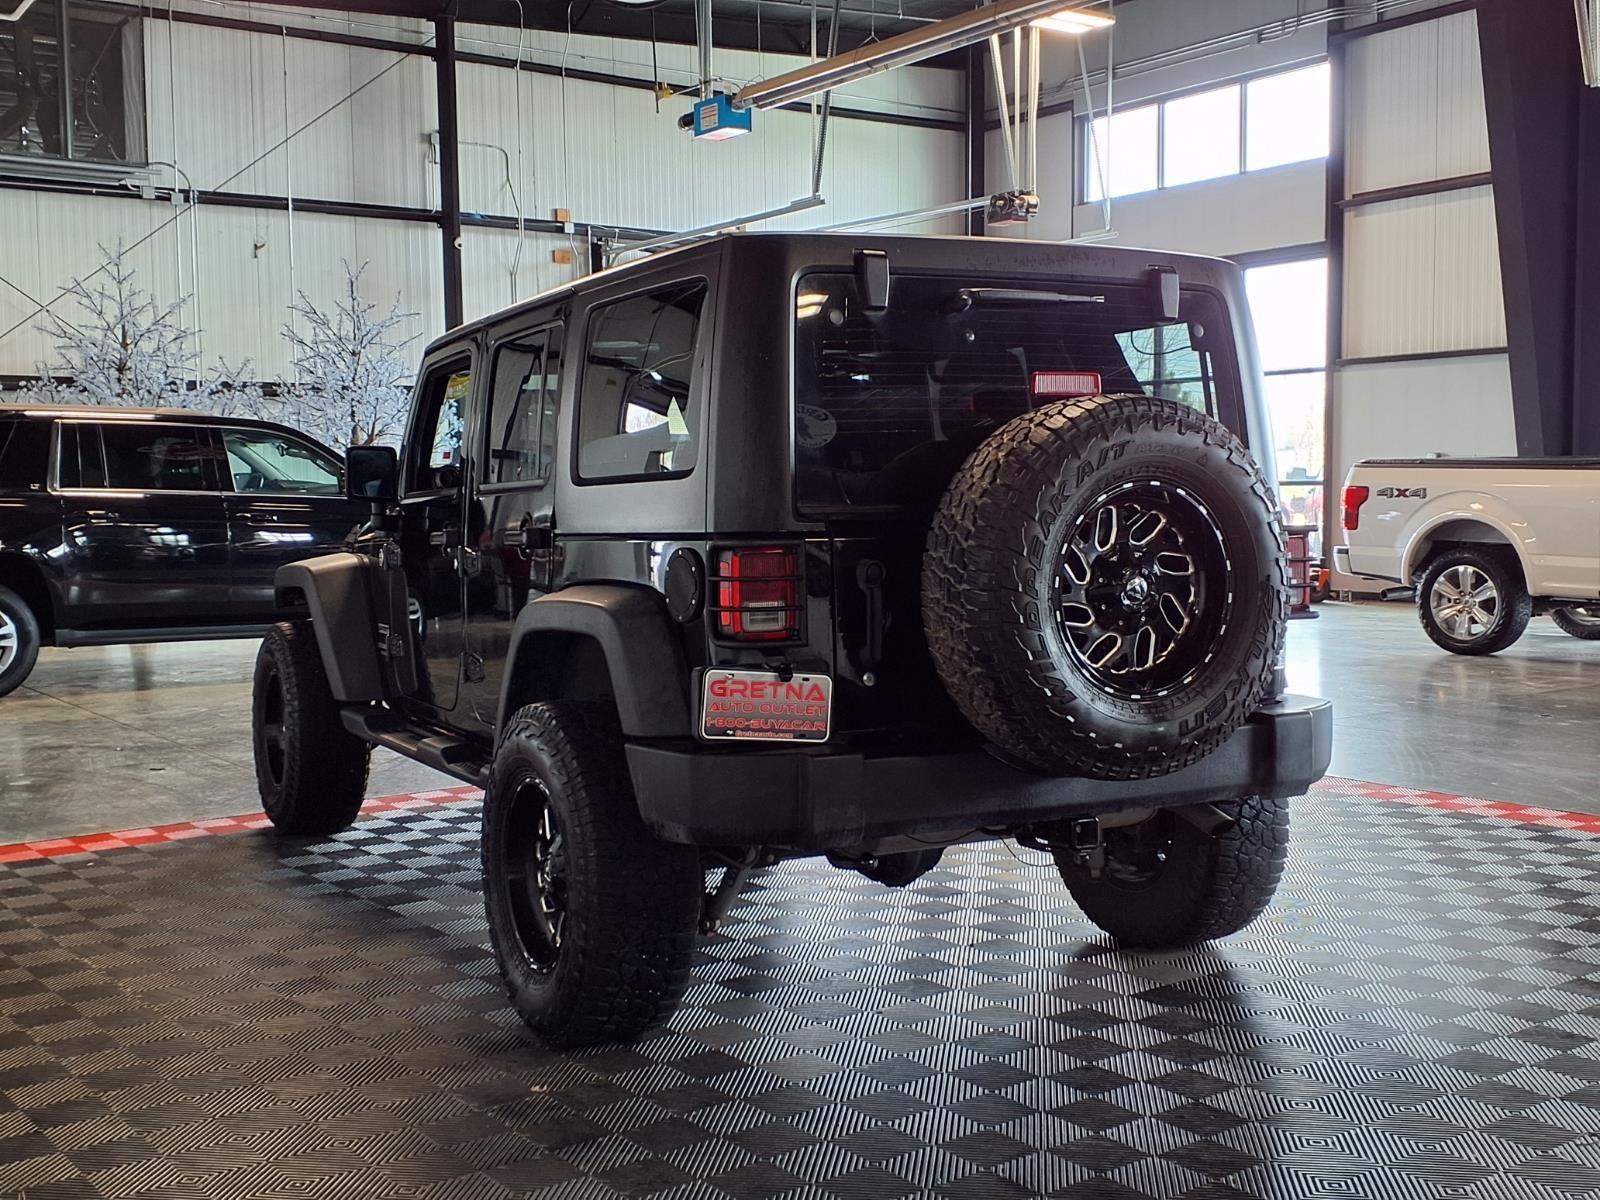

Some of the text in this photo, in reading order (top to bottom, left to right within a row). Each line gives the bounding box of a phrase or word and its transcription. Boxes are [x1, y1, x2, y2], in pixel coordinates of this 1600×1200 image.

[710, 679, 825, 702] GRETNA
[709, 702, 825, 716] AUTO OUTLET
[706, 717, 826, 731] 1-800-BUYACAR
